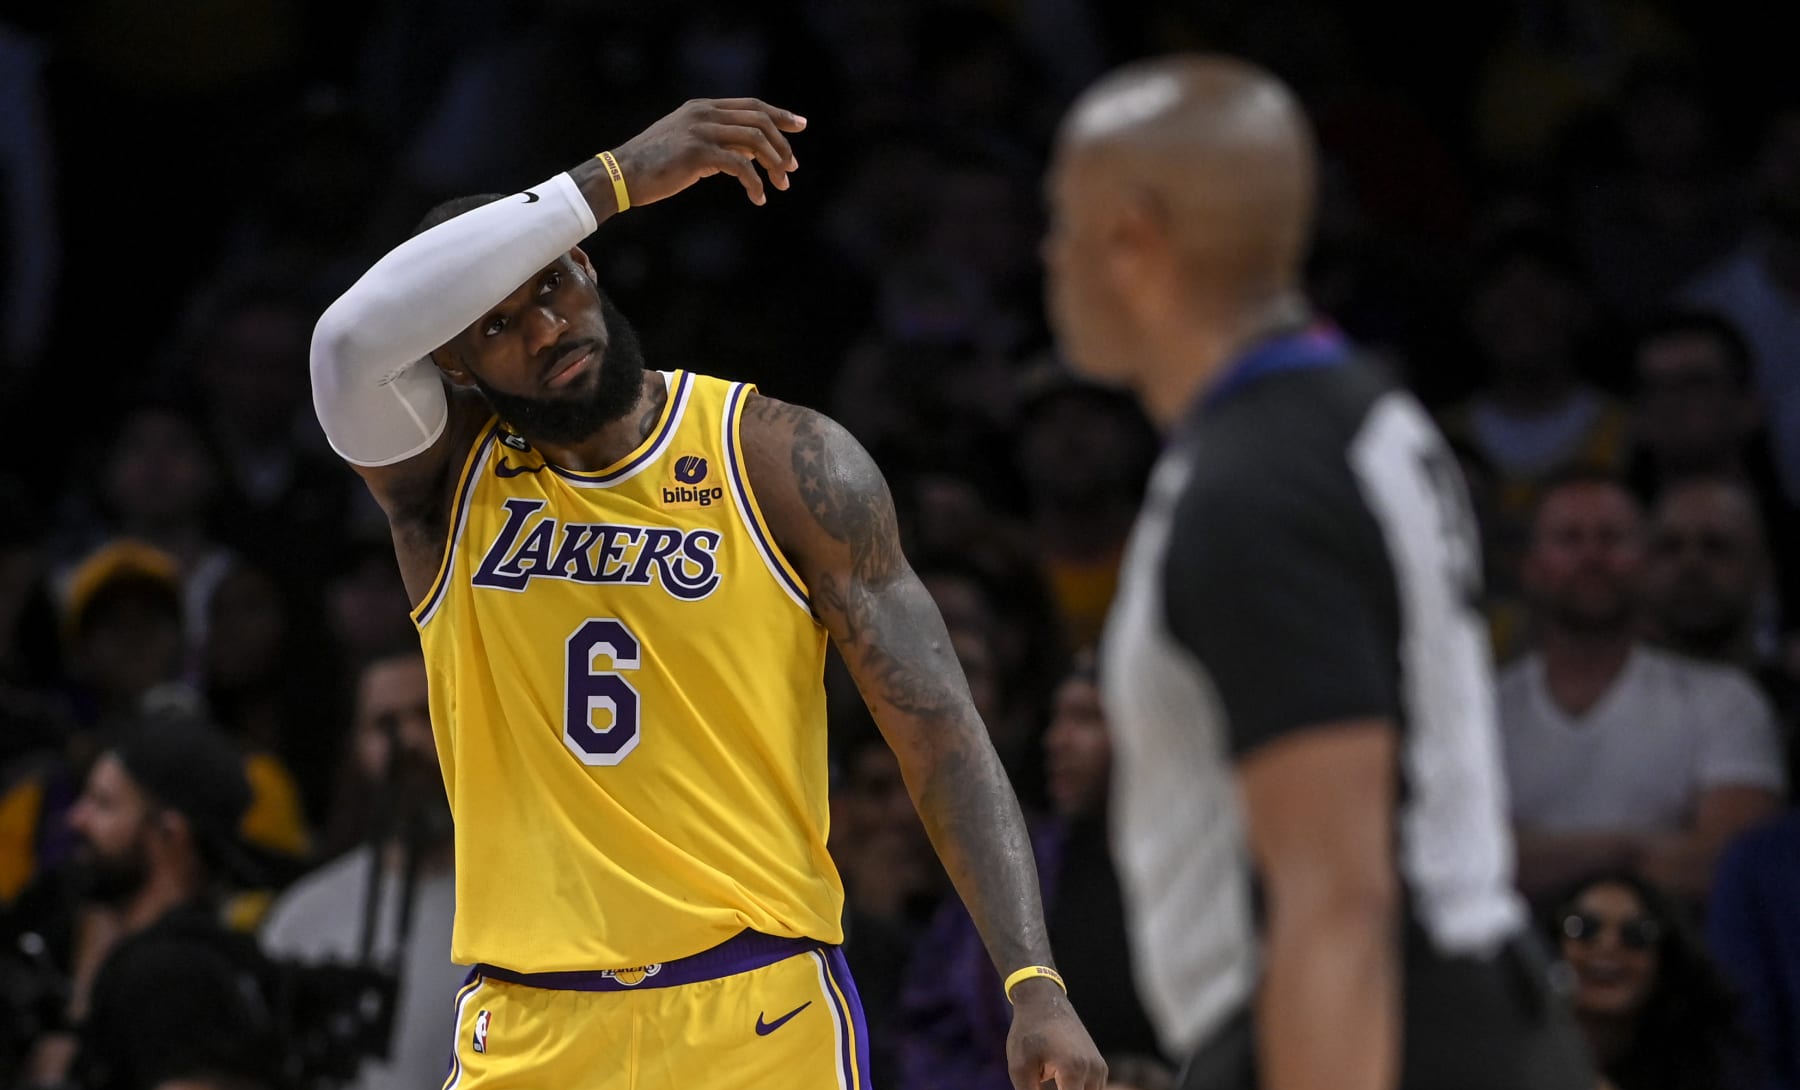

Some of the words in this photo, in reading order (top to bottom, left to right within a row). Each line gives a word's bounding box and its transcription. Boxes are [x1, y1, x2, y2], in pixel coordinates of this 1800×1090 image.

[663, 486, 722, 506] bibigo
[472, 497, 723, 601] LAKERS
[563, 617, 640, 766] 6
